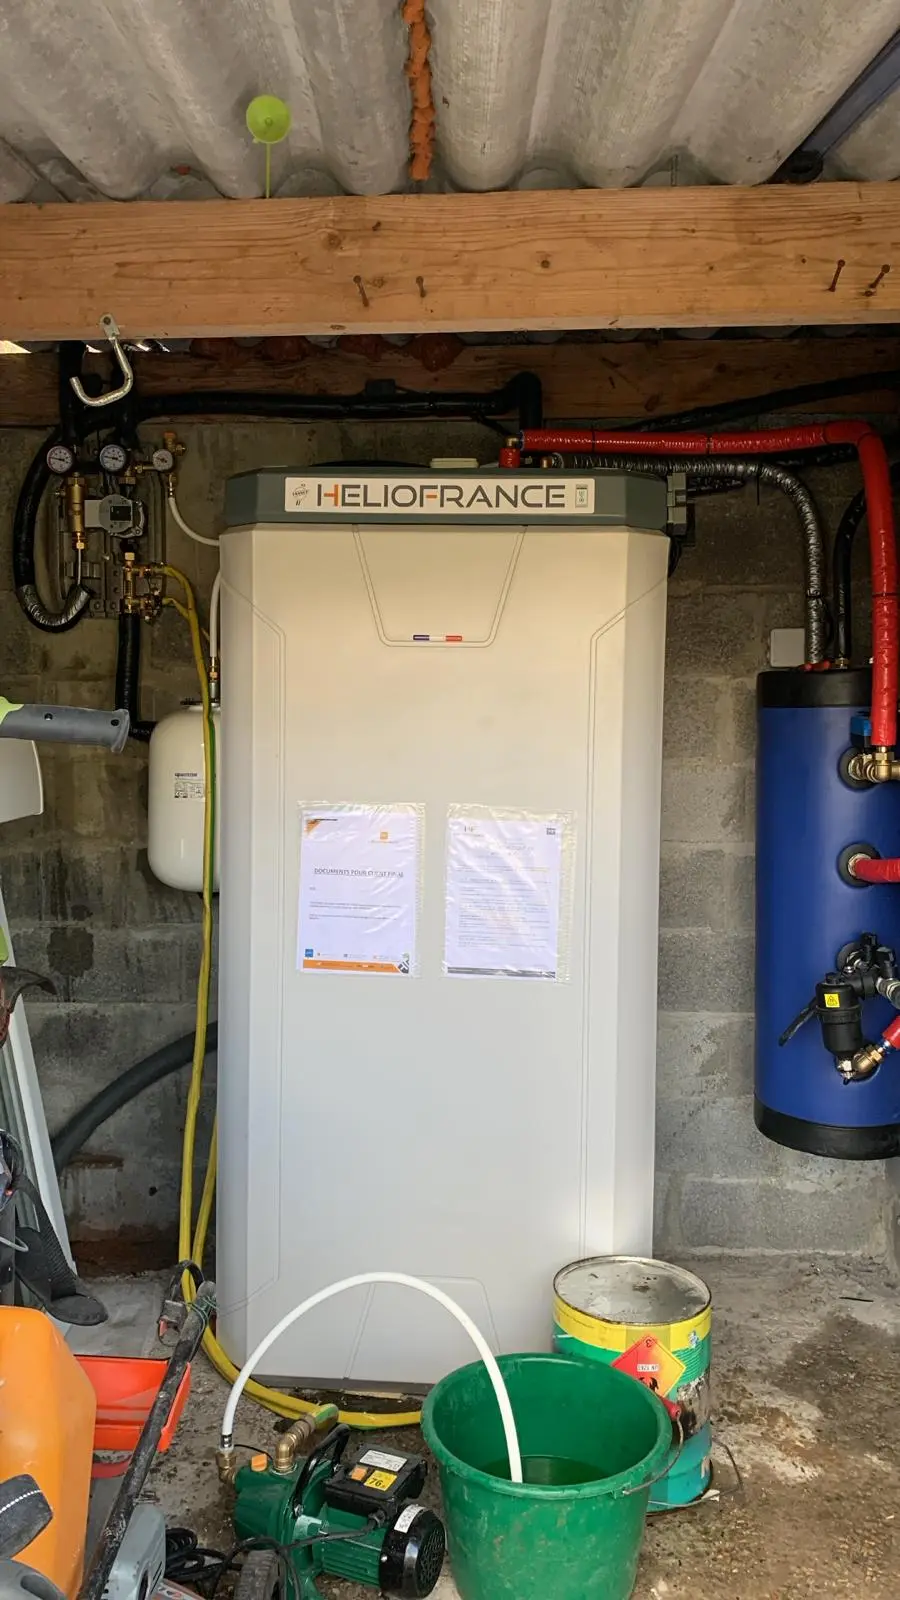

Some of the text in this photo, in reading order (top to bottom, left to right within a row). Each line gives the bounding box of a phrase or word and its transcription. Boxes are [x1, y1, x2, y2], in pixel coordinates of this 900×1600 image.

[317, 484, 566, 508] HELIOFRANCE
[314, 867, 350, 876] DOCUMENTS
[369, 1477, 383, 1487] 76
